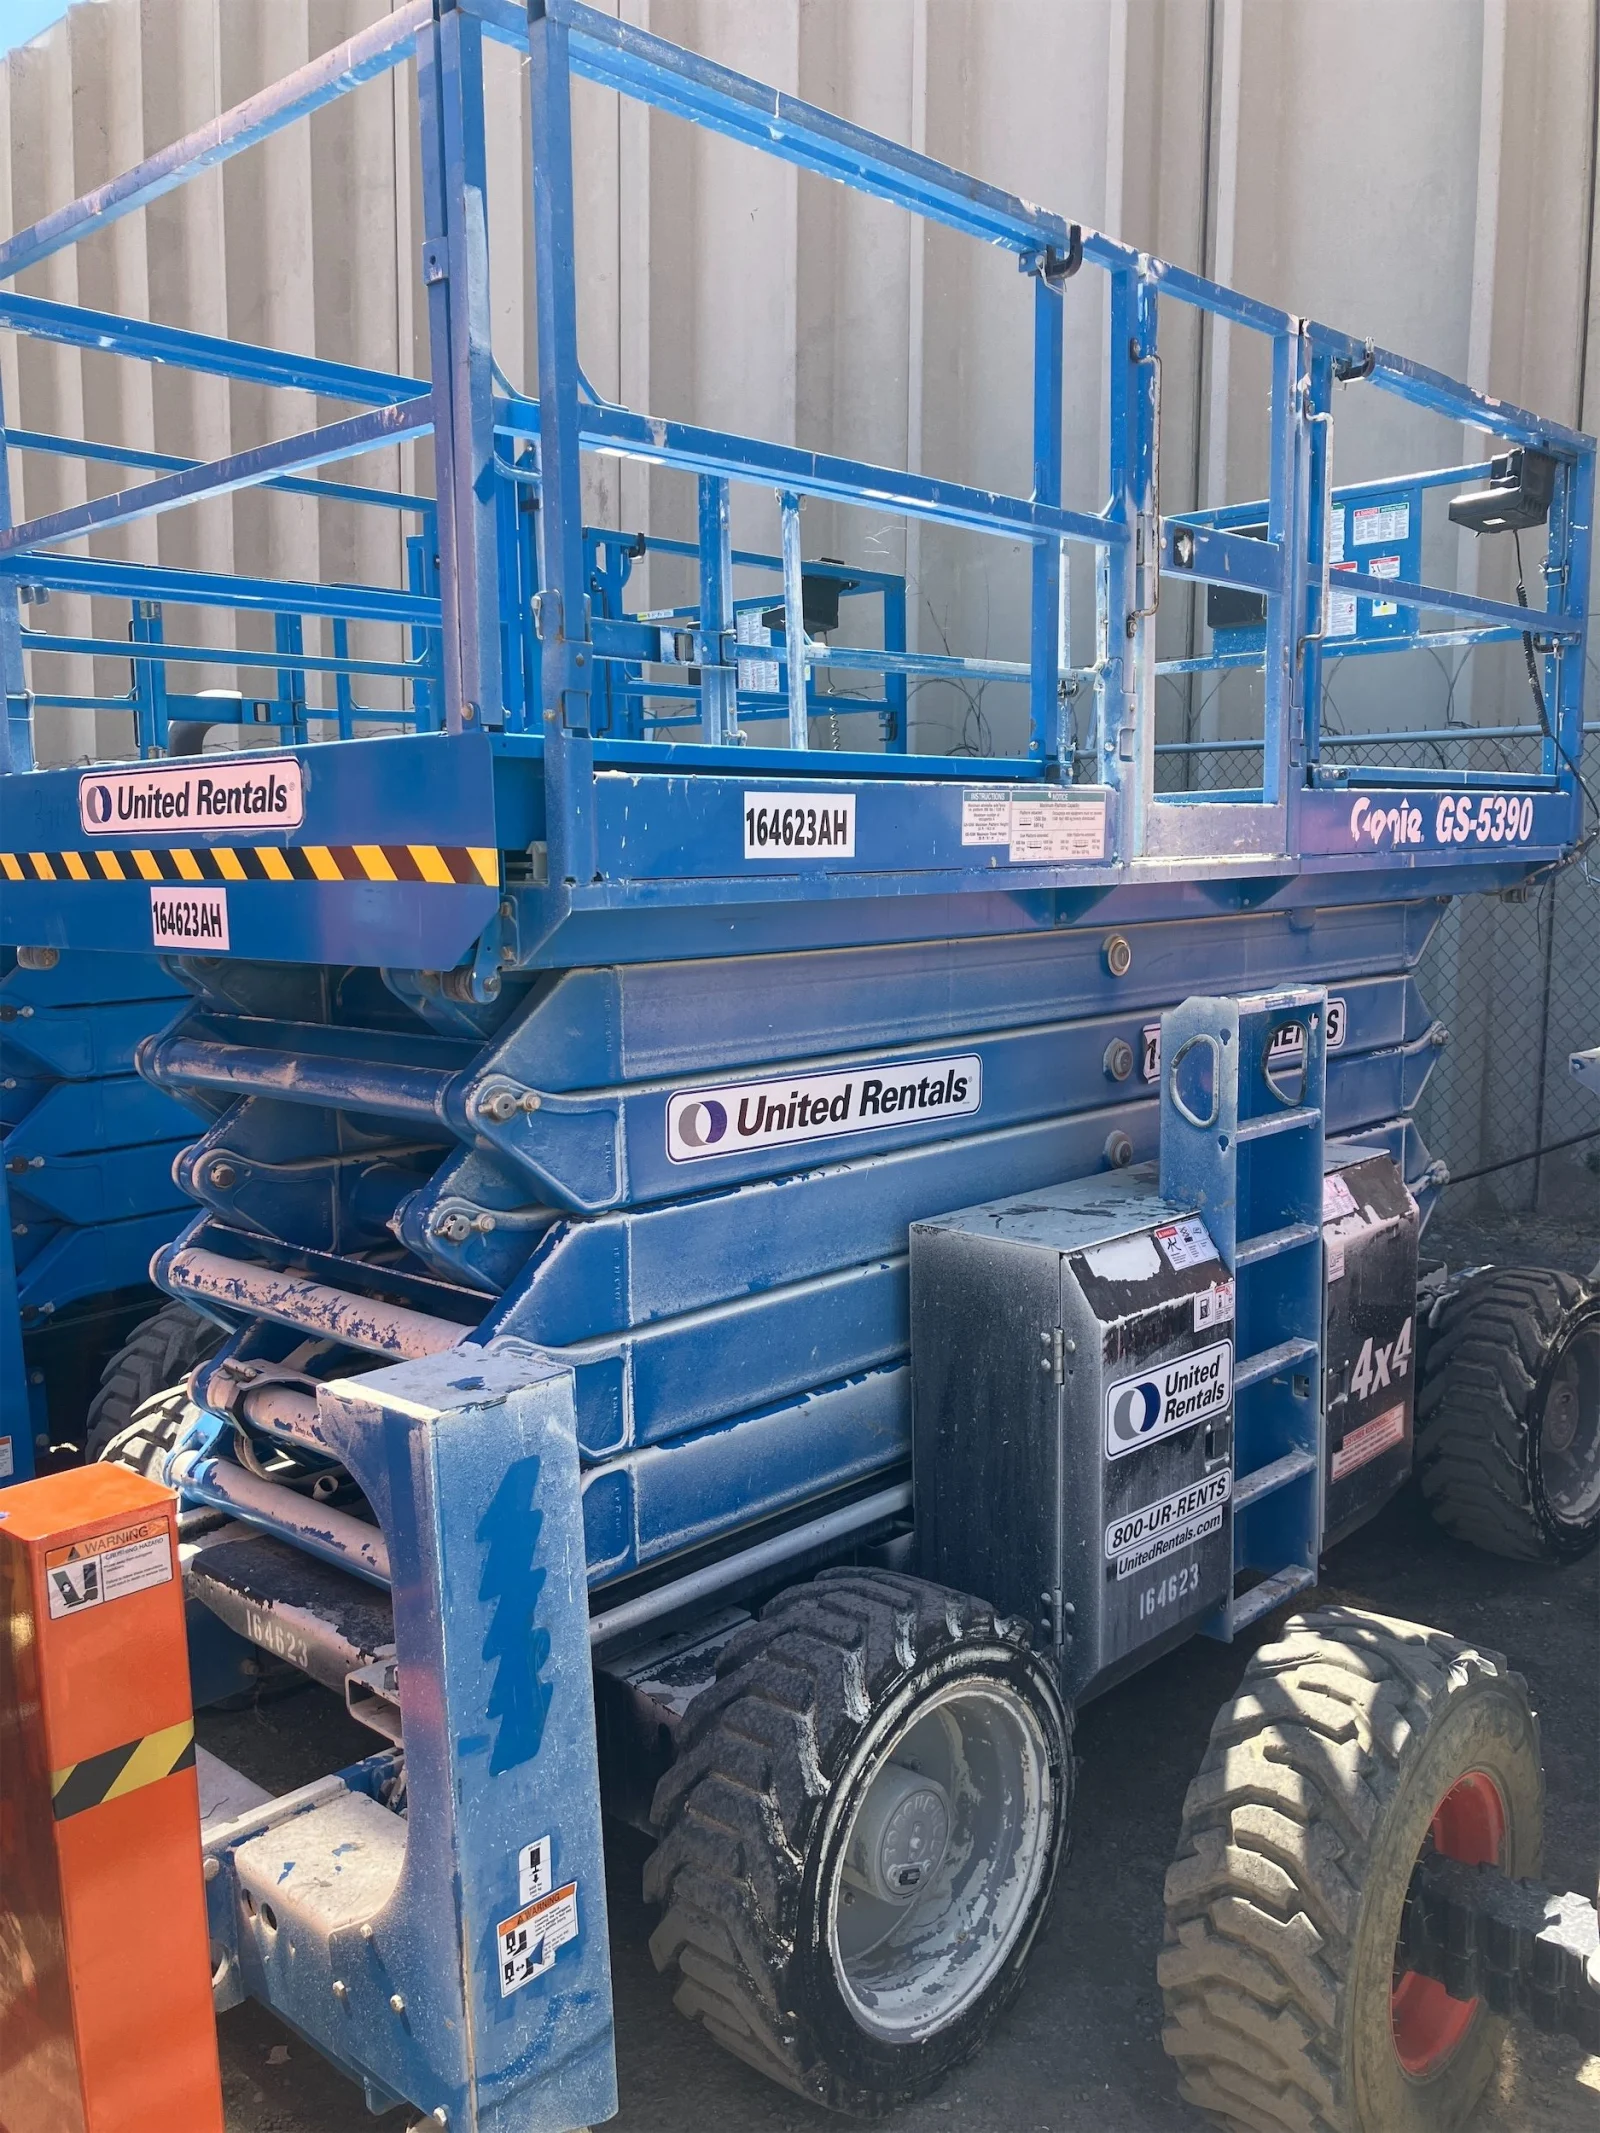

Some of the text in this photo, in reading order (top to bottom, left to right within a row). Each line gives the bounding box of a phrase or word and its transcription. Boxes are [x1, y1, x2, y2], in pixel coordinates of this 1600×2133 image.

[118, 781, 190, 820] United
[197, 774, 287, 816] Rentals
[1436, 796, 1533, 843] GS-5390
[745, 807, 847, 846] 164623AH
[153, 901, 222, 938] 164623AH
[737, 1069, 968, 1137] United Rentals
[1165, 1354, 1221, 1397] United
[1350, 1316, 1412, 1400] 4x4
[1164, 1380, 1225, 1424] Rentals
[84, 1526, 148, 1554] WARNING
[139, 1537, 164, 1550] HAZARD
[1118, 1514, 1220, 1575] UnitedRentals.com
[1140, 1562, 1199, 1621] 164623
[246, 1608, 309, 1669] 164623
[525, 1892, 560, 1920] WARNING
